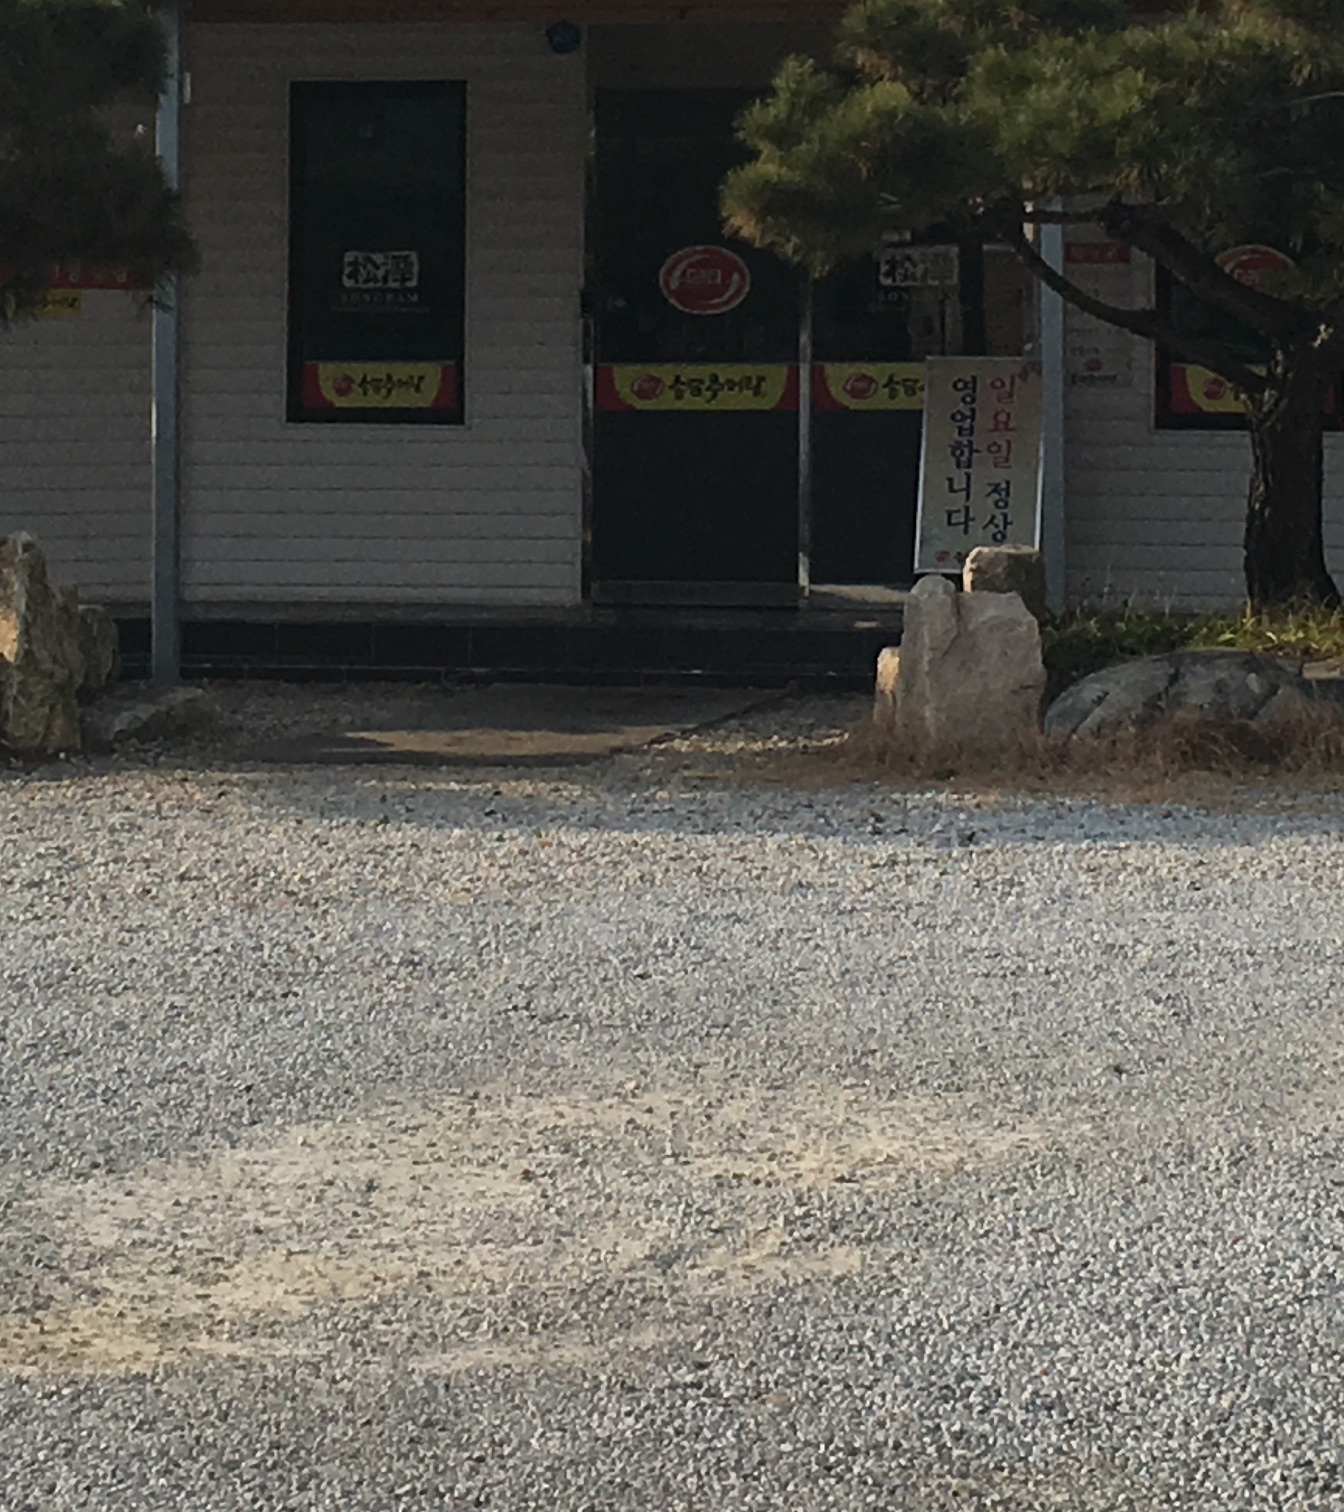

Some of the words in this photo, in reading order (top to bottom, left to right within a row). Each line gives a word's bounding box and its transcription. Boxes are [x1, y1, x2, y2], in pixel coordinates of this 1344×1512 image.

[945, 374, 982, 536] 영업합니다
[986, 374, 1016, 470] 일요일
[982, 480, 1014, 543] 정상
